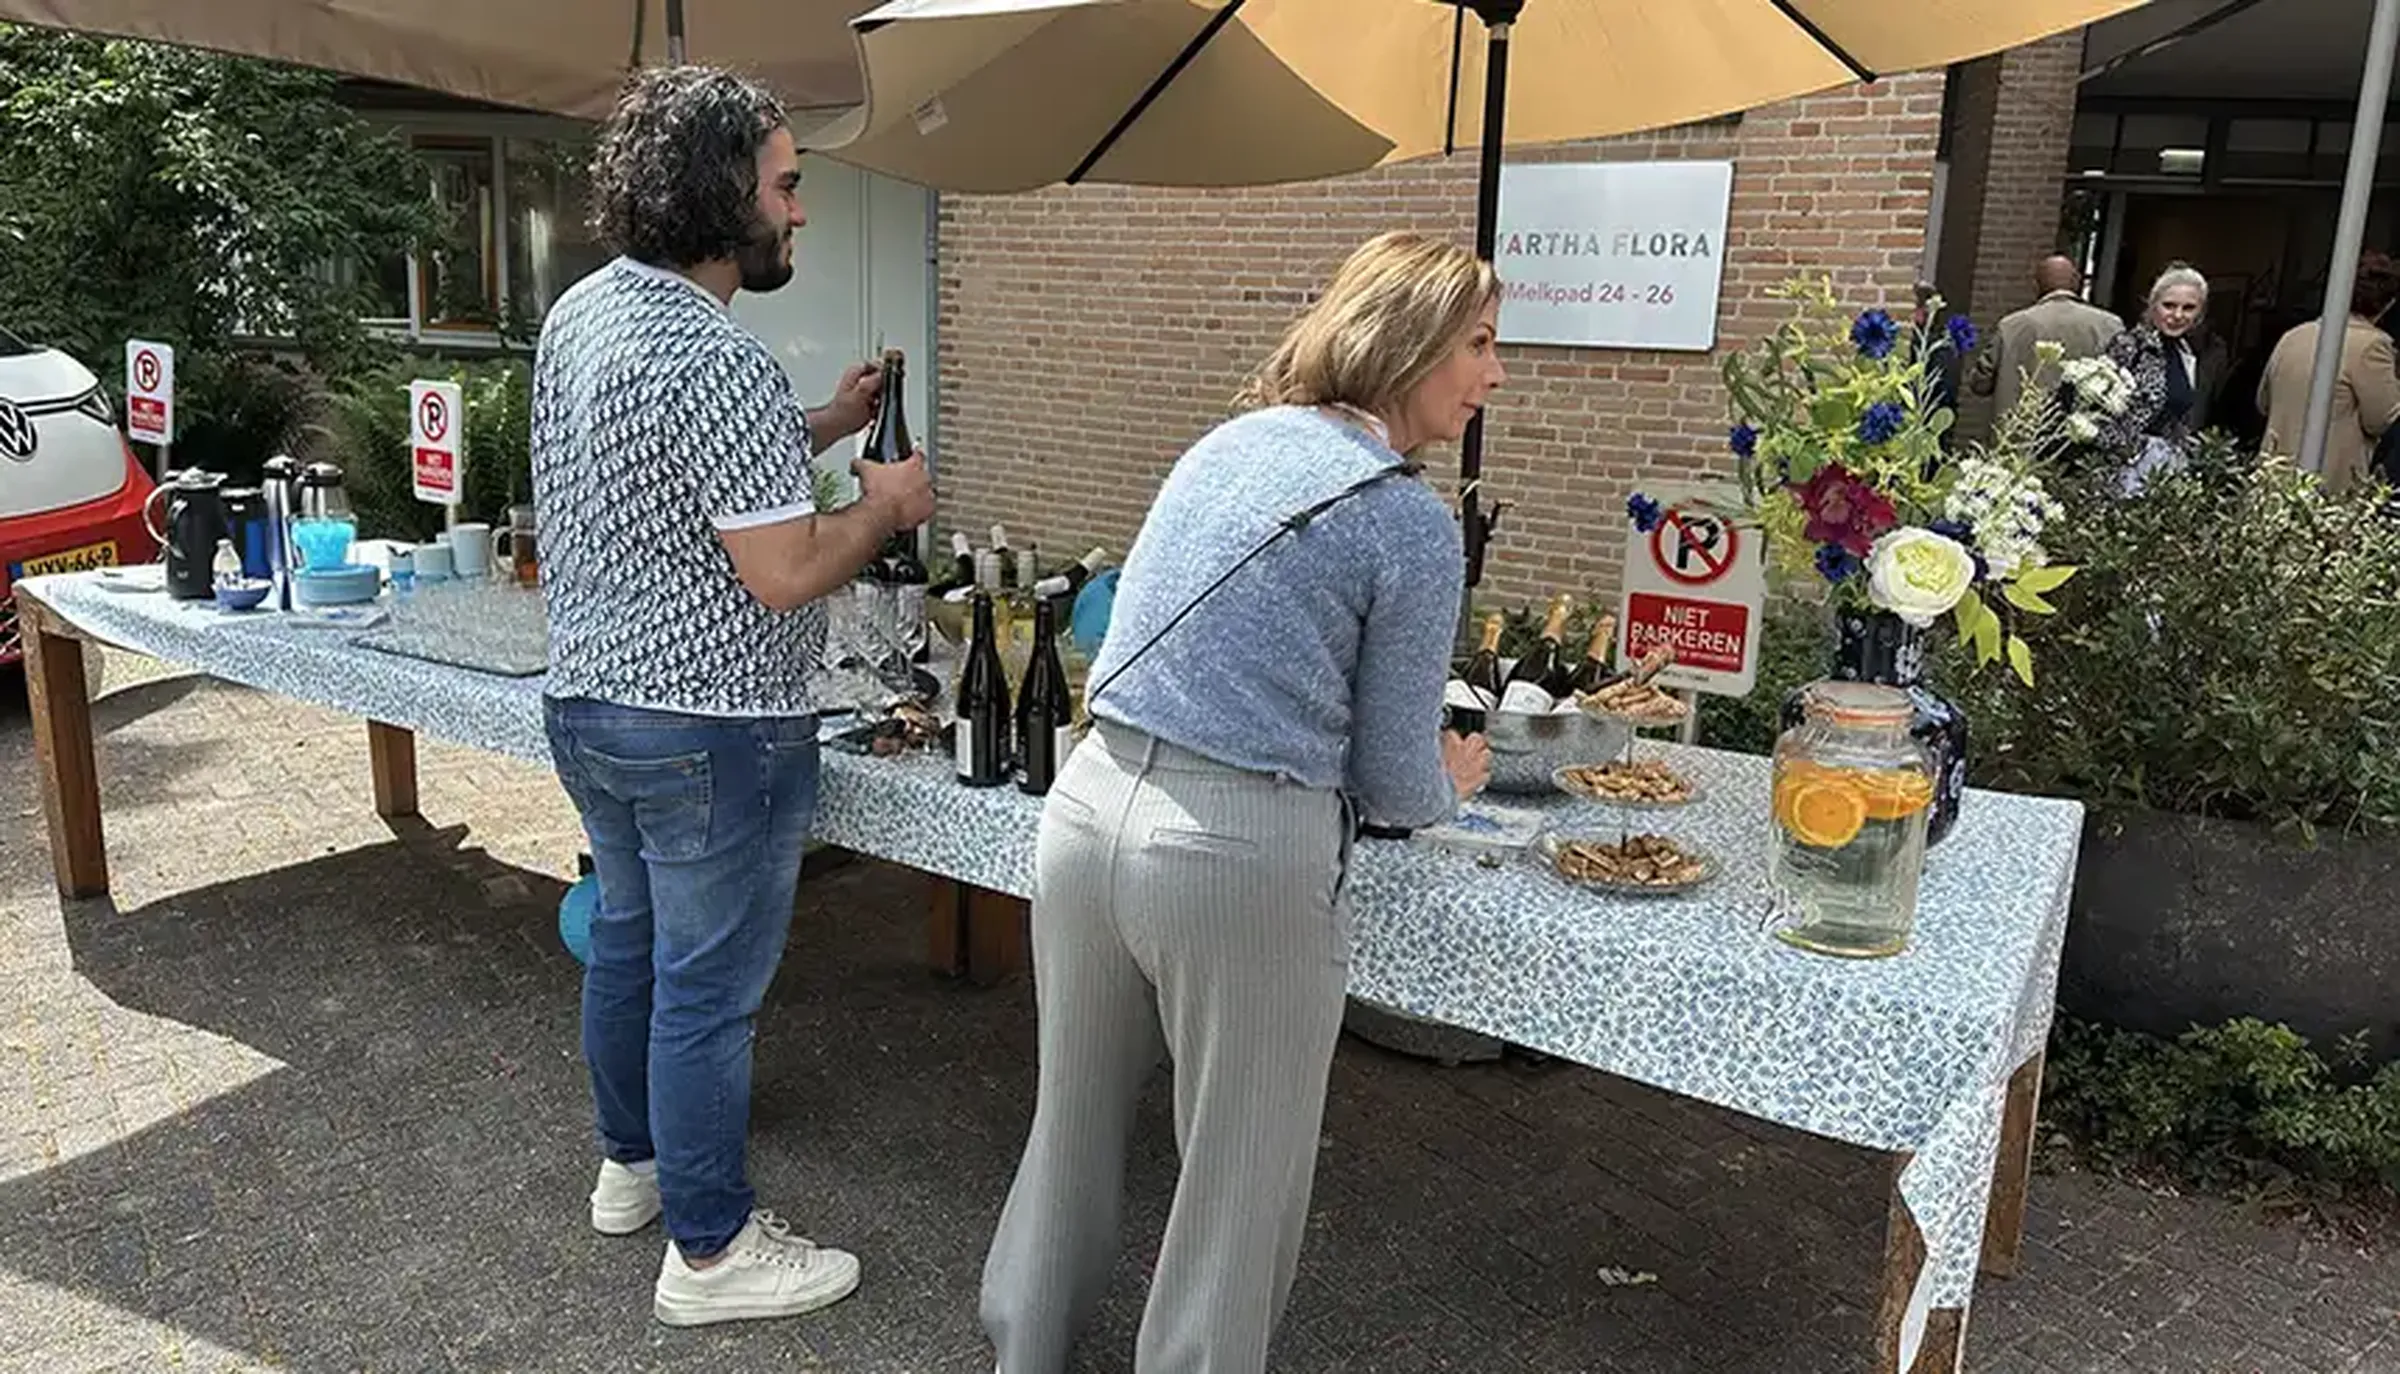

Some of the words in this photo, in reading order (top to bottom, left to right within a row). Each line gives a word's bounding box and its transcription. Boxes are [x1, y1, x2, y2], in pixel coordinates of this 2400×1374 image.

[1499, 232, 1599, 256] ARTHA
[1612, 232, 1710, 257] FLORA
[1598, 282, 1625, 304] 24
[1645, 283, 1675, 305] 26
[1664, 606, 1709, 628] NIET
[1631, 622, 1740, 654] PARKEREN
